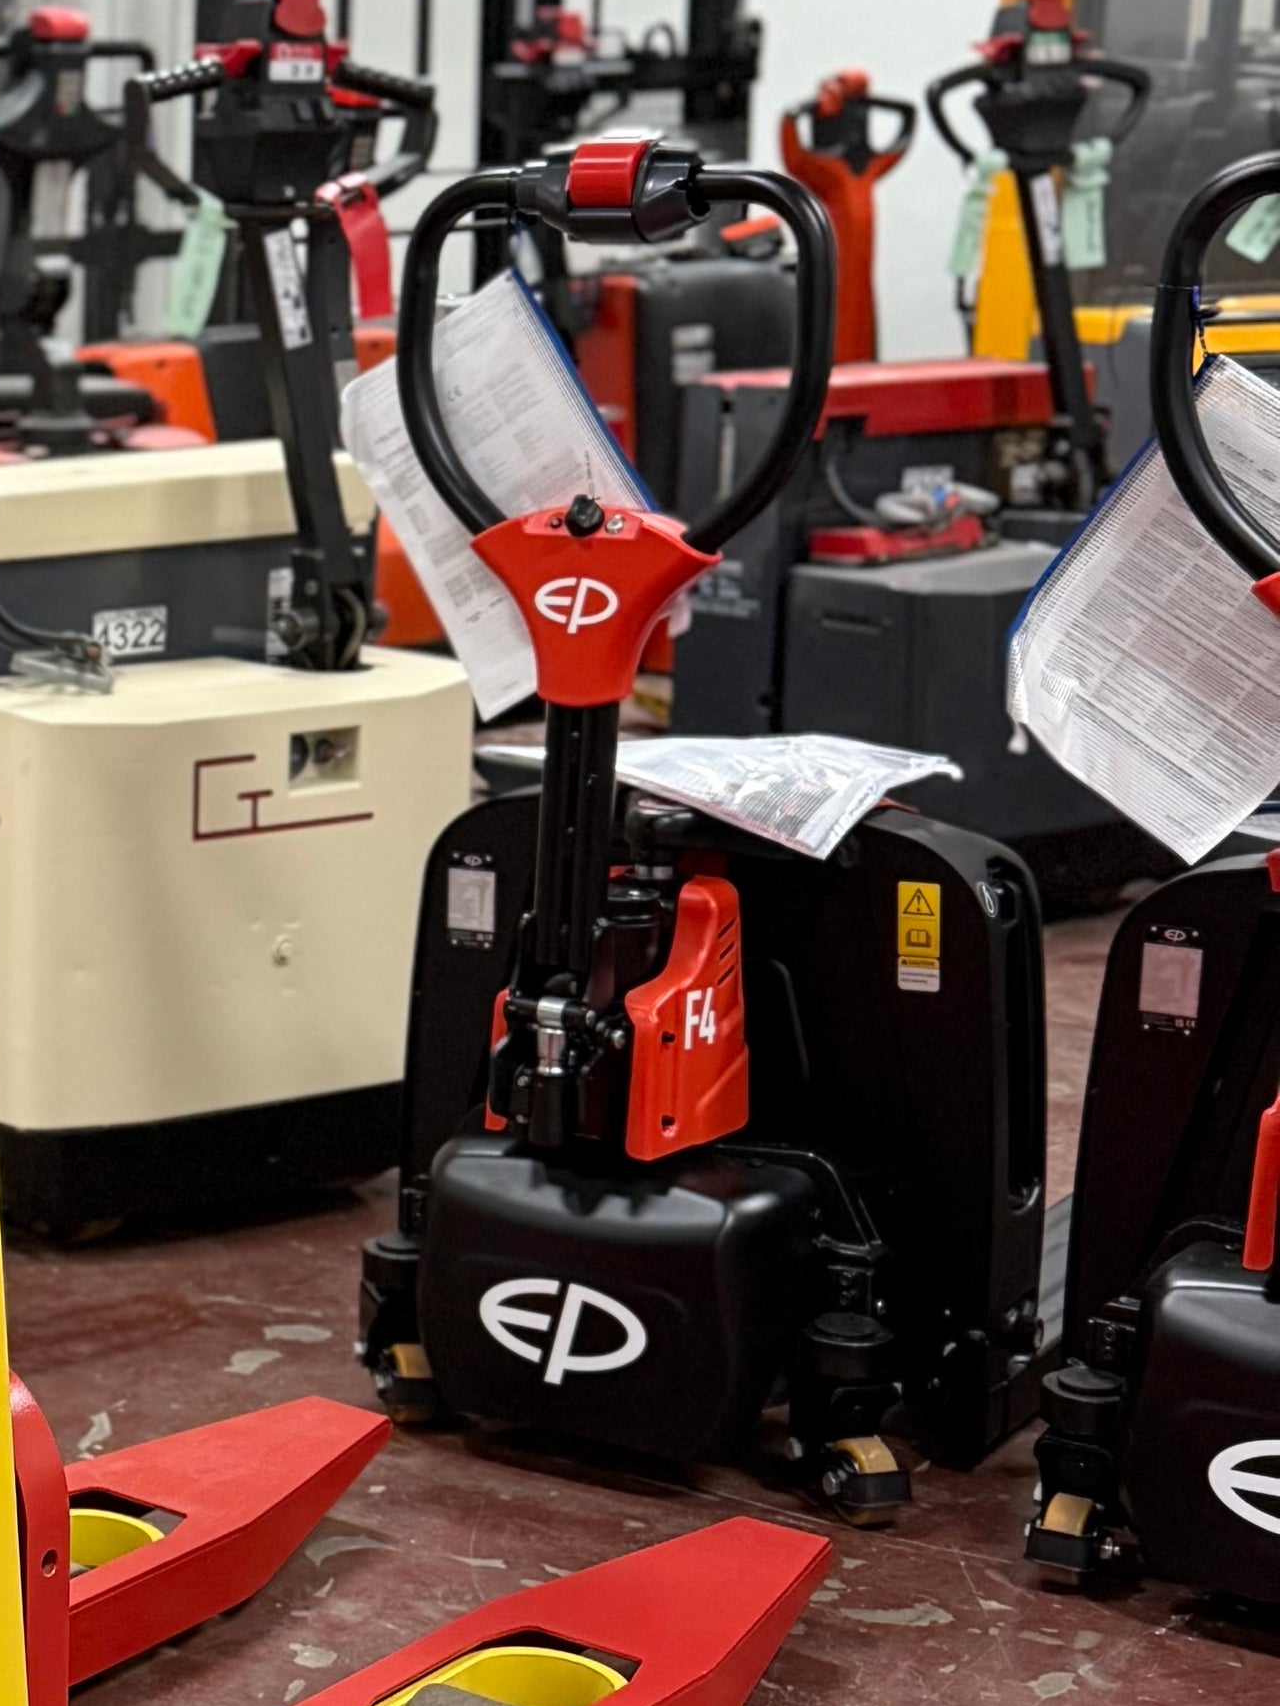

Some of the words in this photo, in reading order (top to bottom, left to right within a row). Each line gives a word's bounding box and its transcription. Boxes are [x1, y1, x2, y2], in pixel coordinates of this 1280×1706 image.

[98, 619, 166, 650] 4322
[534, 577, 619, 634] EP
[684, 986, 717, 1050] F4
[479, 1278, 647, 1385] EP
